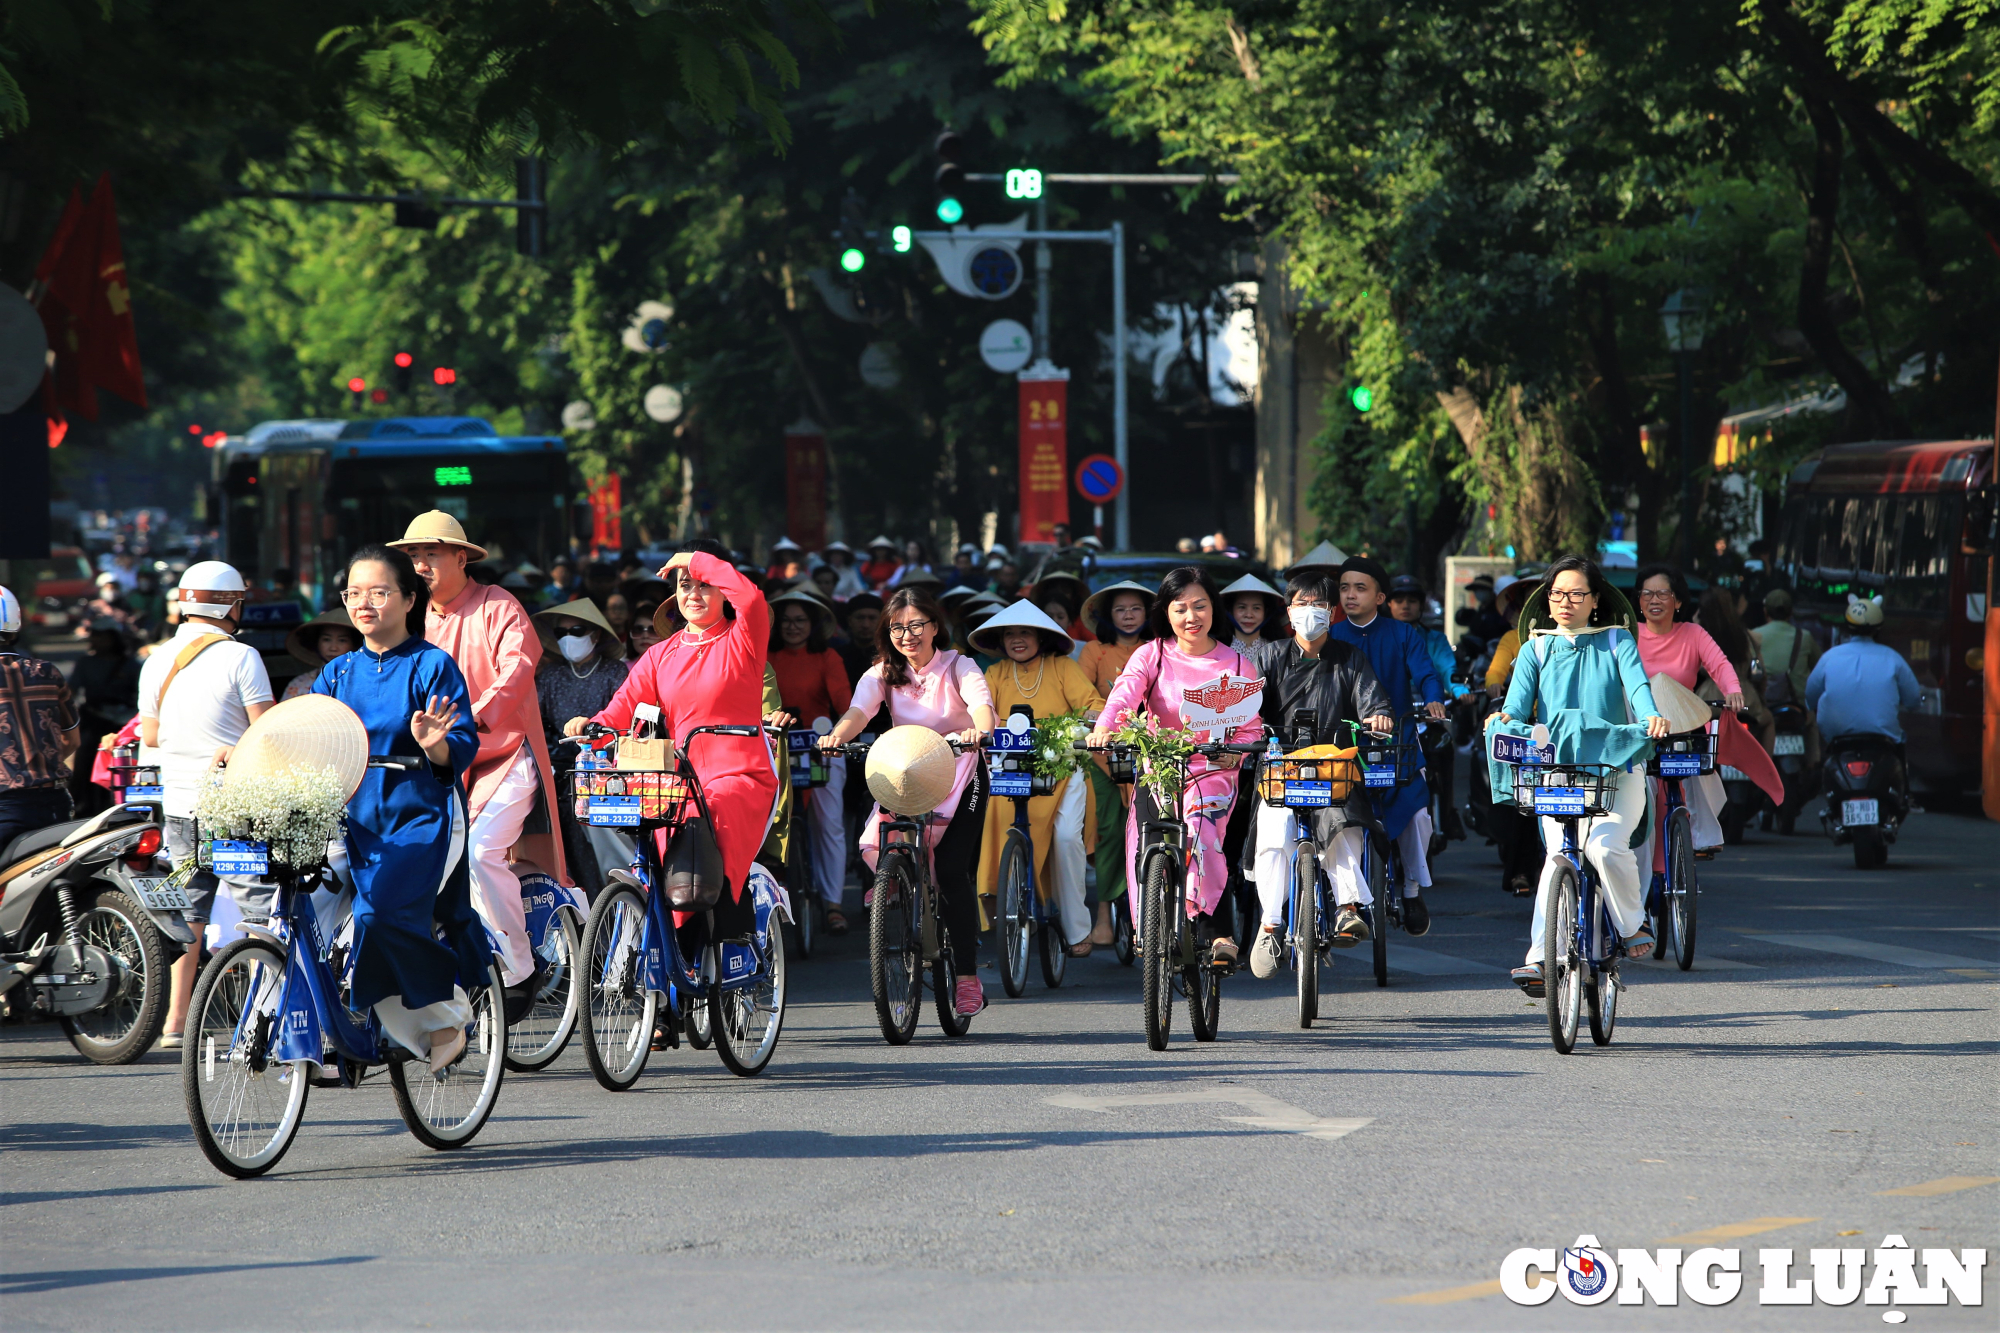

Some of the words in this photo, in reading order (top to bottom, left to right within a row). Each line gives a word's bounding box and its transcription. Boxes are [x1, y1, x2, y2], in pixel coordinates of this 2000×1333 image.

[1006, 168, 1043, 199] 08
[1191, 720, 1211, 728] ĐÌNH
[1231, 714, 1249, 723] VIỆT
[1497, 739, 1509, 757] Du
[1287, 796, 1329, 804] X29B-23.949
[1538, 804, 1582, 813] X29A-23.626
[215, 862, 266, 872] X29K-23.666
[147, 894, 186, 907] 9866
[291, 1010, 308, 1029] TN
